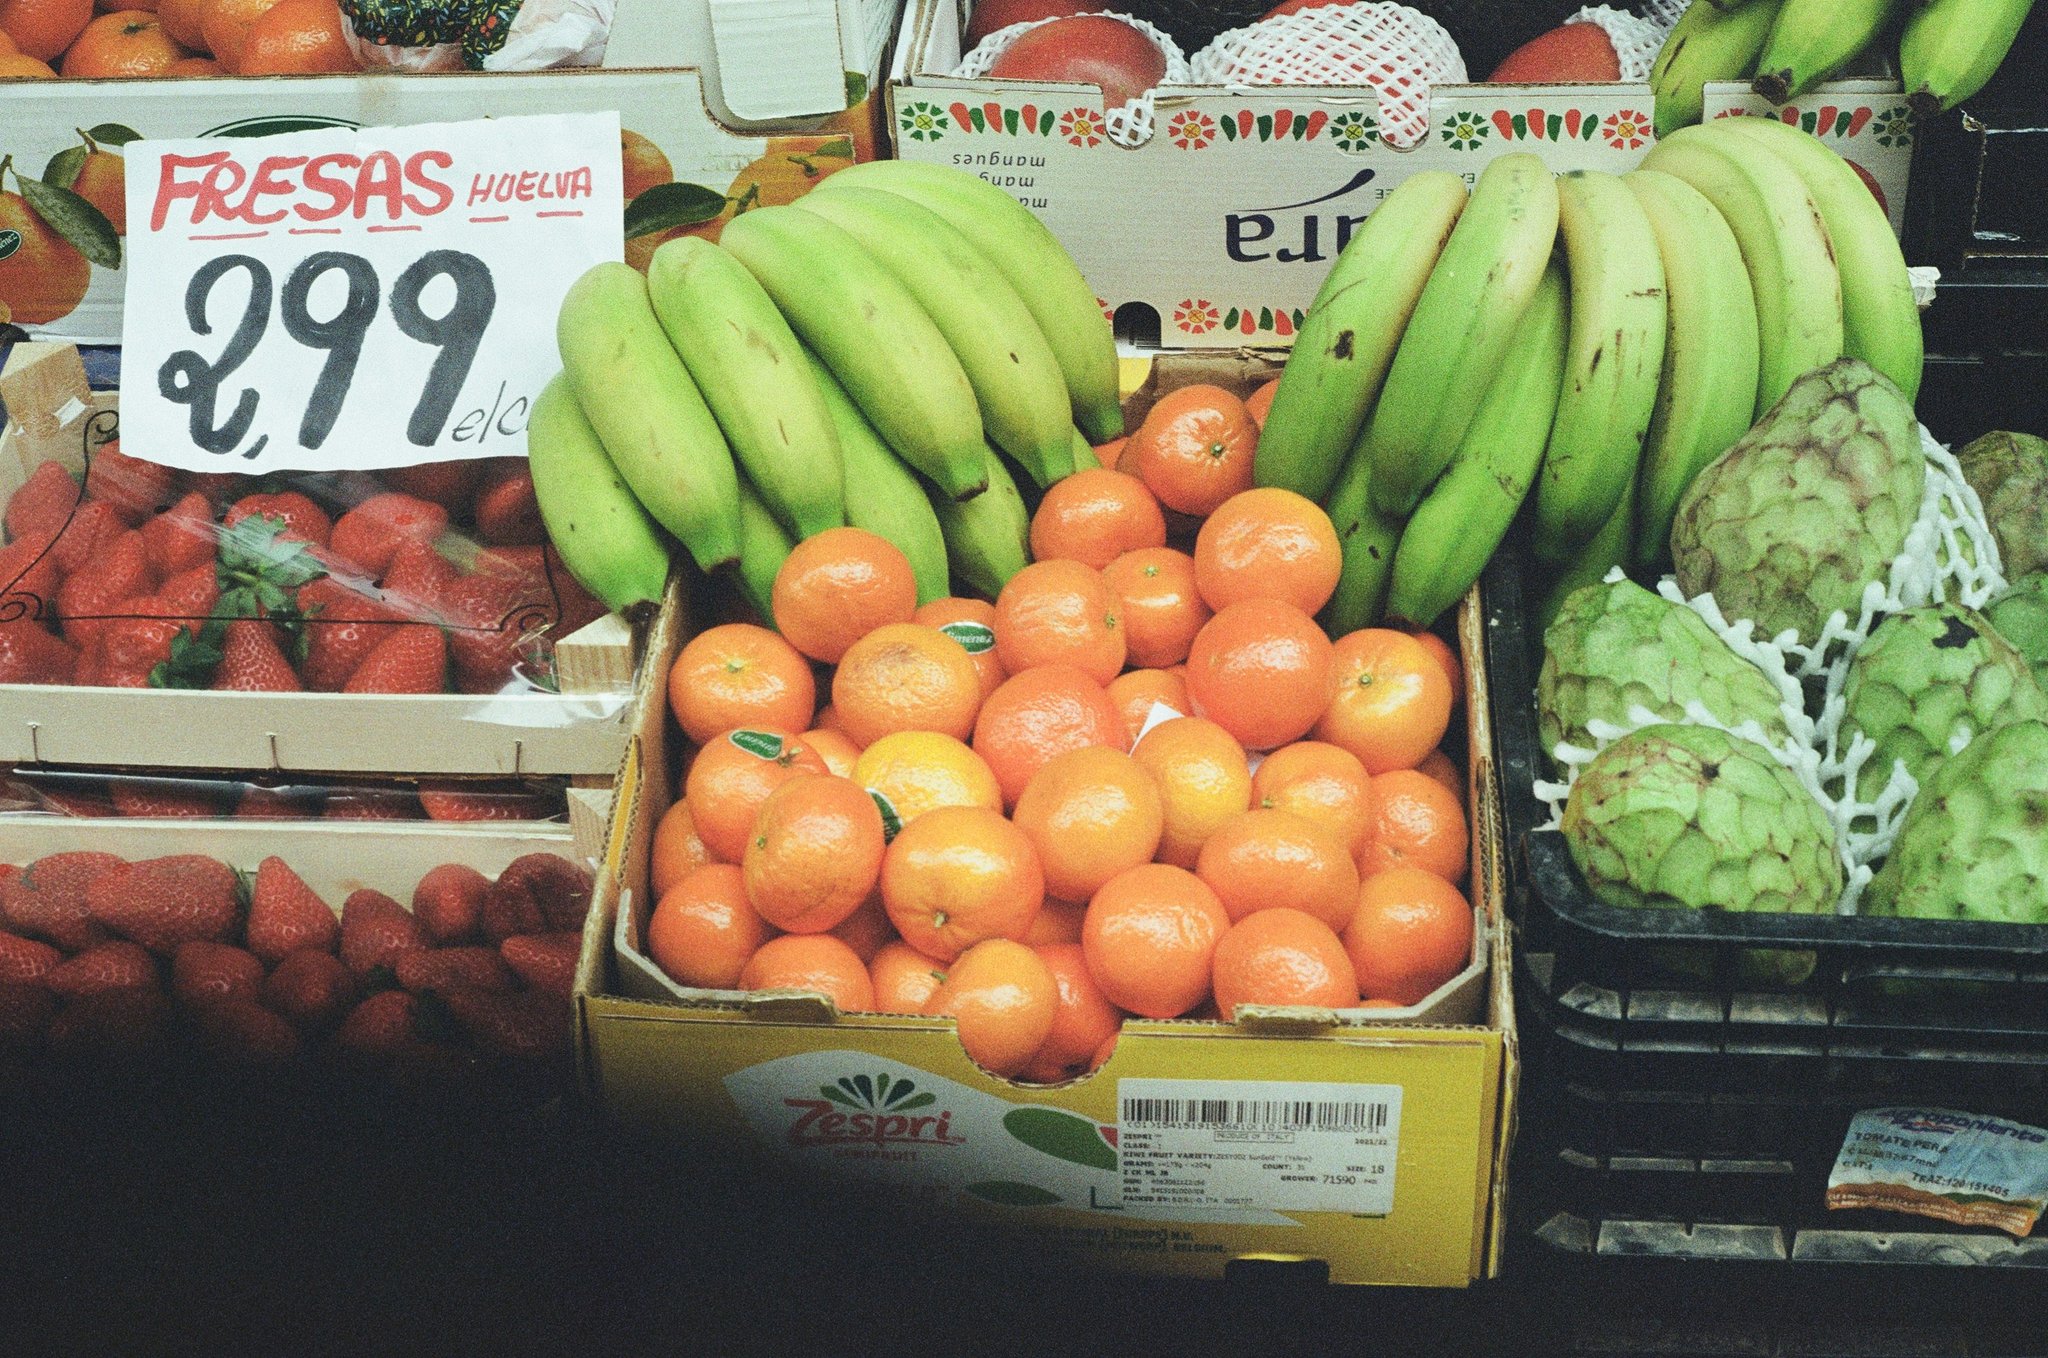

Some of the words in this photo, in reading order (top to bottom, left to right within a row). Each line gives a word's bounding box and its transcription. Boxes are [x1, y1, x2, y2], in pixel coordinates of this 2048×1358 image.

[952, 150, 1046, 168] mangues
[150, 148, 454, 233] FRESAS
[467, 165, 594, 207] HUELVA
[157, 248, 497, 460] 2,99
[784, 1097, 964, 1148] Zespri
[1855, 1131, 1911, 1148] TOMATE
[1346, 1165, 1367, 1173] SIZE:
[1370, 1164, 1385, 1174] 18
[1322, 1174, 1356, 1186] 71590
